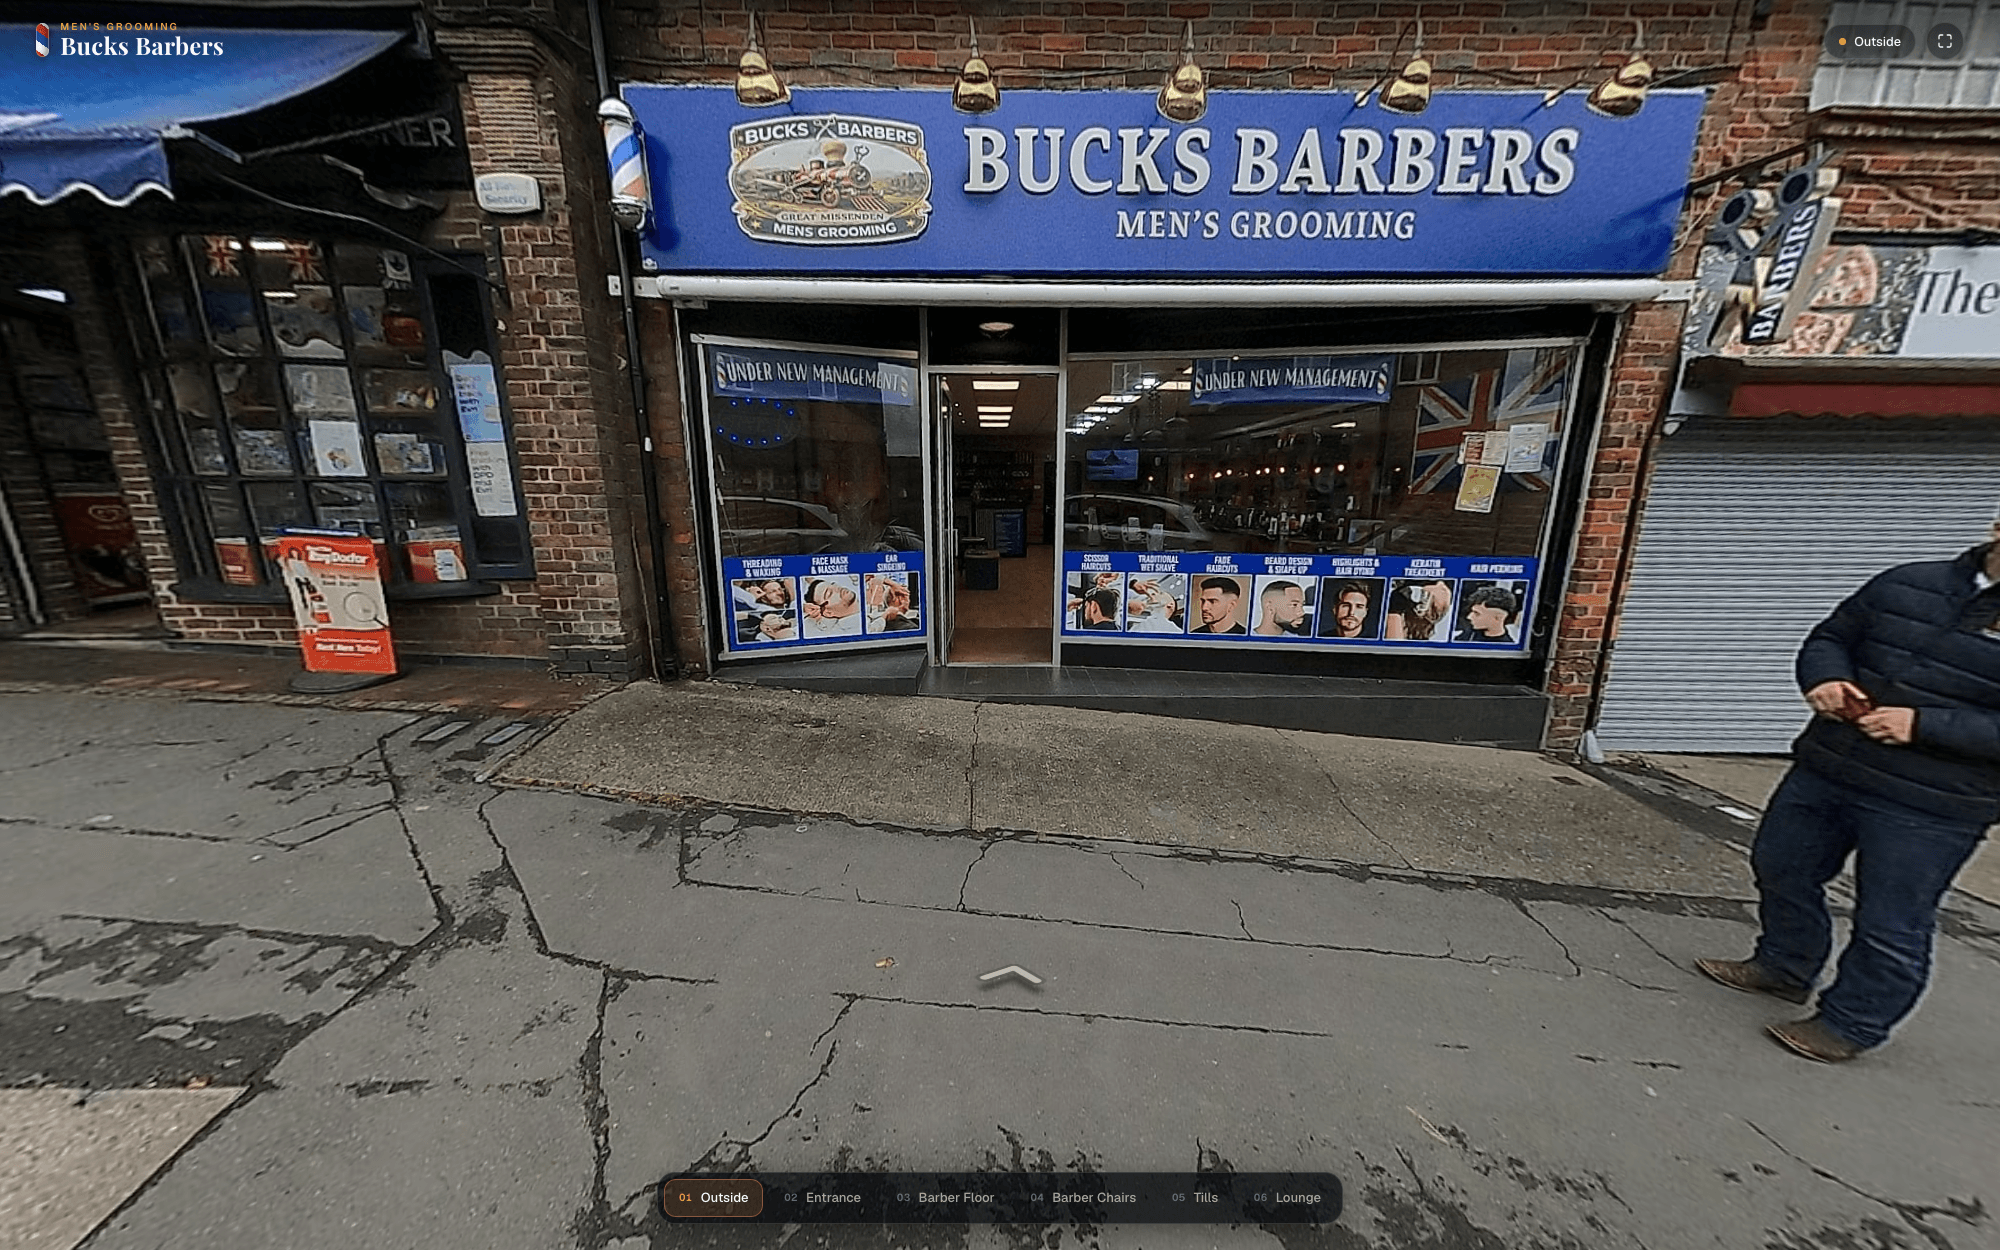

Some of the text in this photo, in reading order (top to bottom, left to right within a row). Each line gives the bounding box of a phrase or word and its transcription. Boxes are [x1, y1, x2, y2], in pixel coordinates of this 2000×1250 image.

[744, 122, 917, 145] BUCKS BARBERS
[962, 127, 1580, 196] BUCKS BARBERS
[781, 212, 884, 221] GREAT MISSENDEN
[1230, 210, 1416, 240] GROOMING
[773, 222, 897, 238] MENS GROOMING
[1748, 203, 1818, 340] BARBERS
[1917, 268, 2000, 314] The
[727, 361, 899, 391] UNDER NEW MANAGEMENT
[1205, 368, 1378, 391] UNDER NEW MANAGEMENT
[742, 559, 783, 568] THREADING
[812, 556, 849, 565] FACE MASK
[885, 555, 898, 563] EAR
[1084, 555, 1109, 563] SCISSOR
[1138, 555, 1179, 564] TRADITIONAL
[1214, 556, 1231, 564] FADE
[1265, 557, 1312, 566] BEARD DESIGN
[1332, 558, 1373, 567] HIGHLIGHTS
[818, 565, 848, 574] MASSAGE
[1081, 563, 1111, 571] HAIRCUTS
[1141, 564, 1176, 572] WET SHAVE
[1206, 565, 1238, 573] HAIRCUTS
[1268, 566, 1308, 574] & SHAPE UP
[1335, 567, 1375, 576] HAIR DYING
[745, 568, 781, 577] & WAXING
